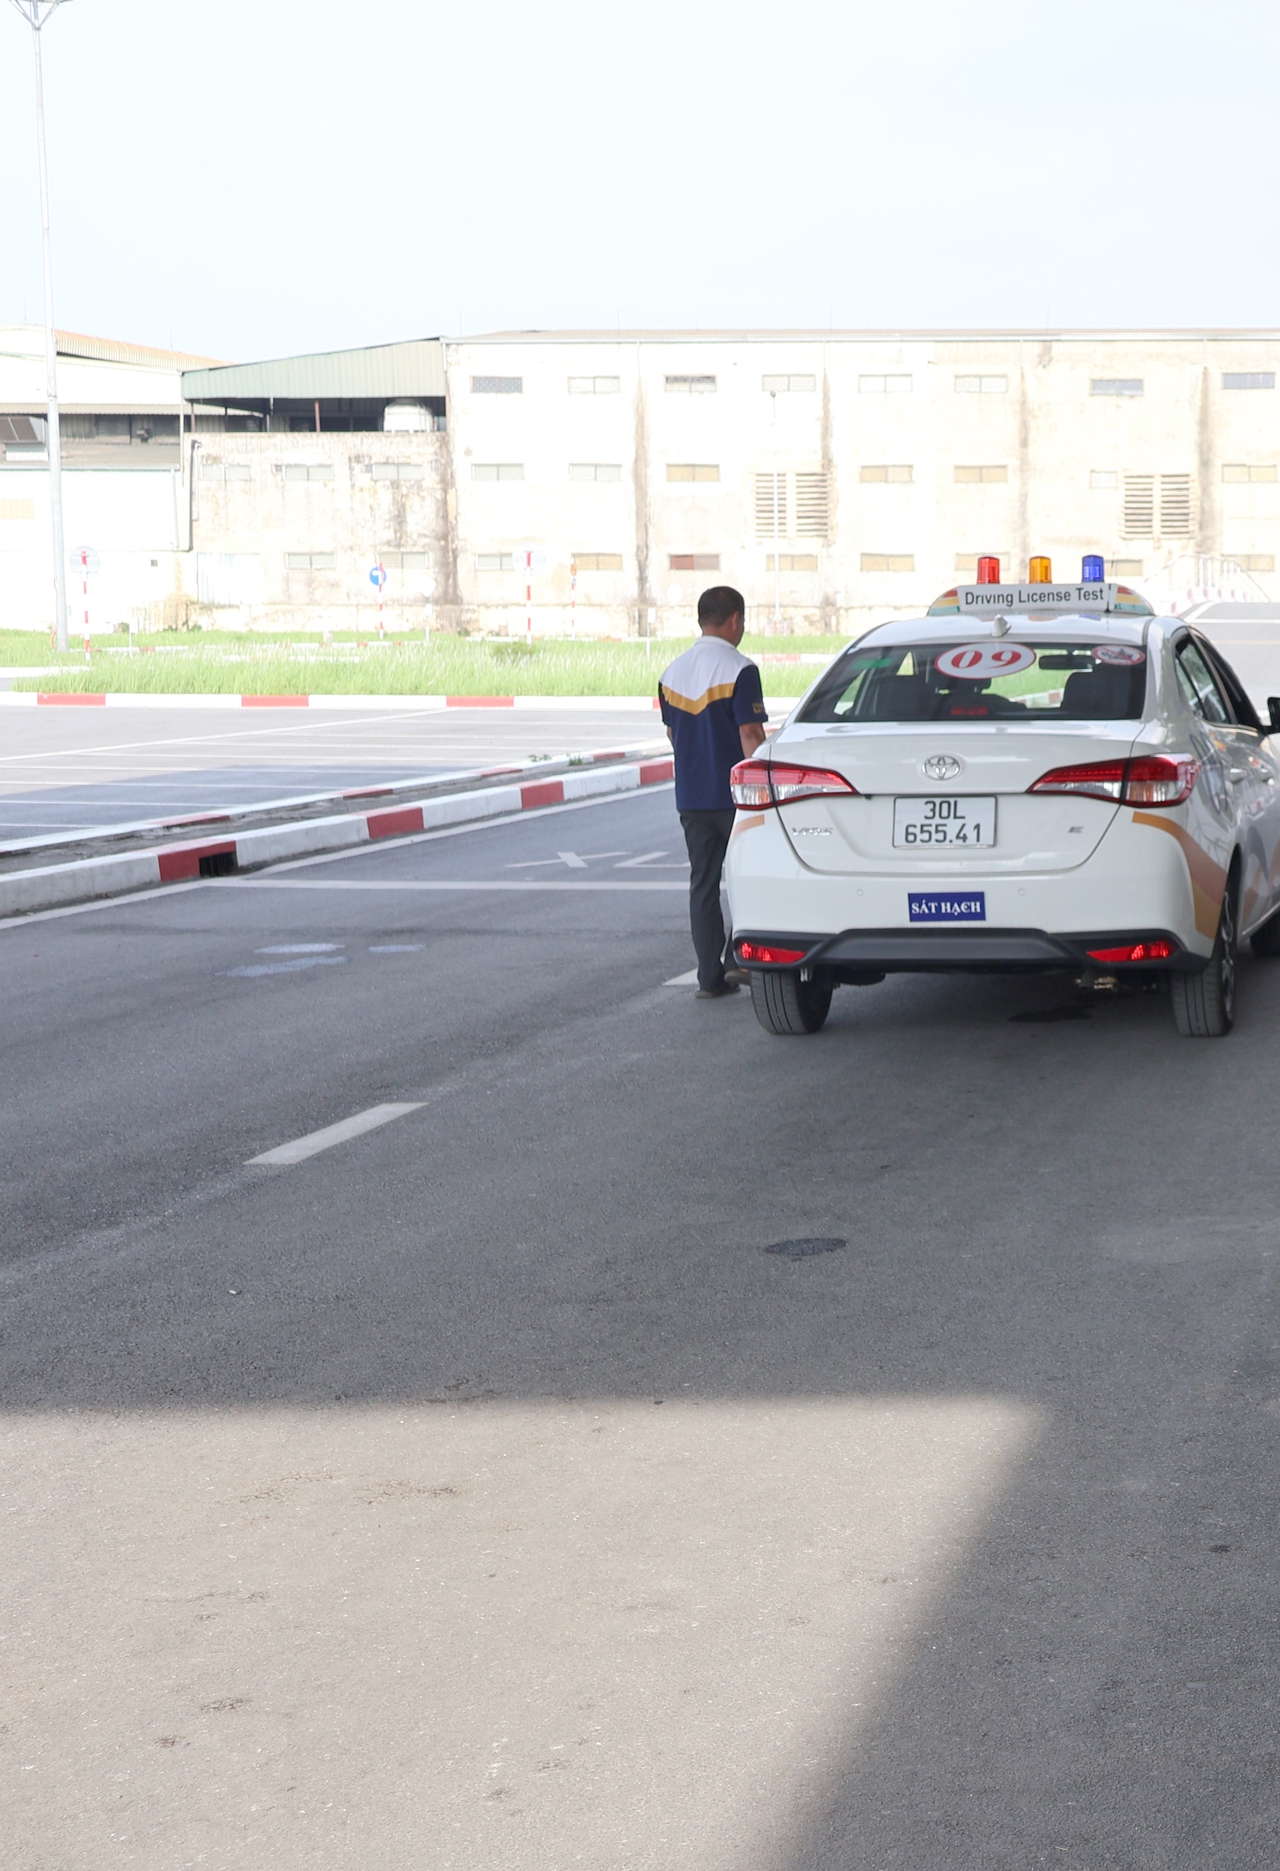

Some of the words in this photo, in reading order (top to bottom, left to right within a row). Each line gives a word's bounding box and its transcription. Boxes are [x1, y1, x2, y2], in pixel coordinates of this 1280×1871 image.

[965, 591, 1014, 607] Driving
[1018, 589, 1071, 604] License
[1076, 586, 1104, 601] Test
[951, 650, 1022, 670] 09
[924, 800, 966, 820] 30L
[904, 823, 981, 844] 655.41
[911, 899, 938, 914] SÁT
[940, 901, 981, 916] HẠCH
